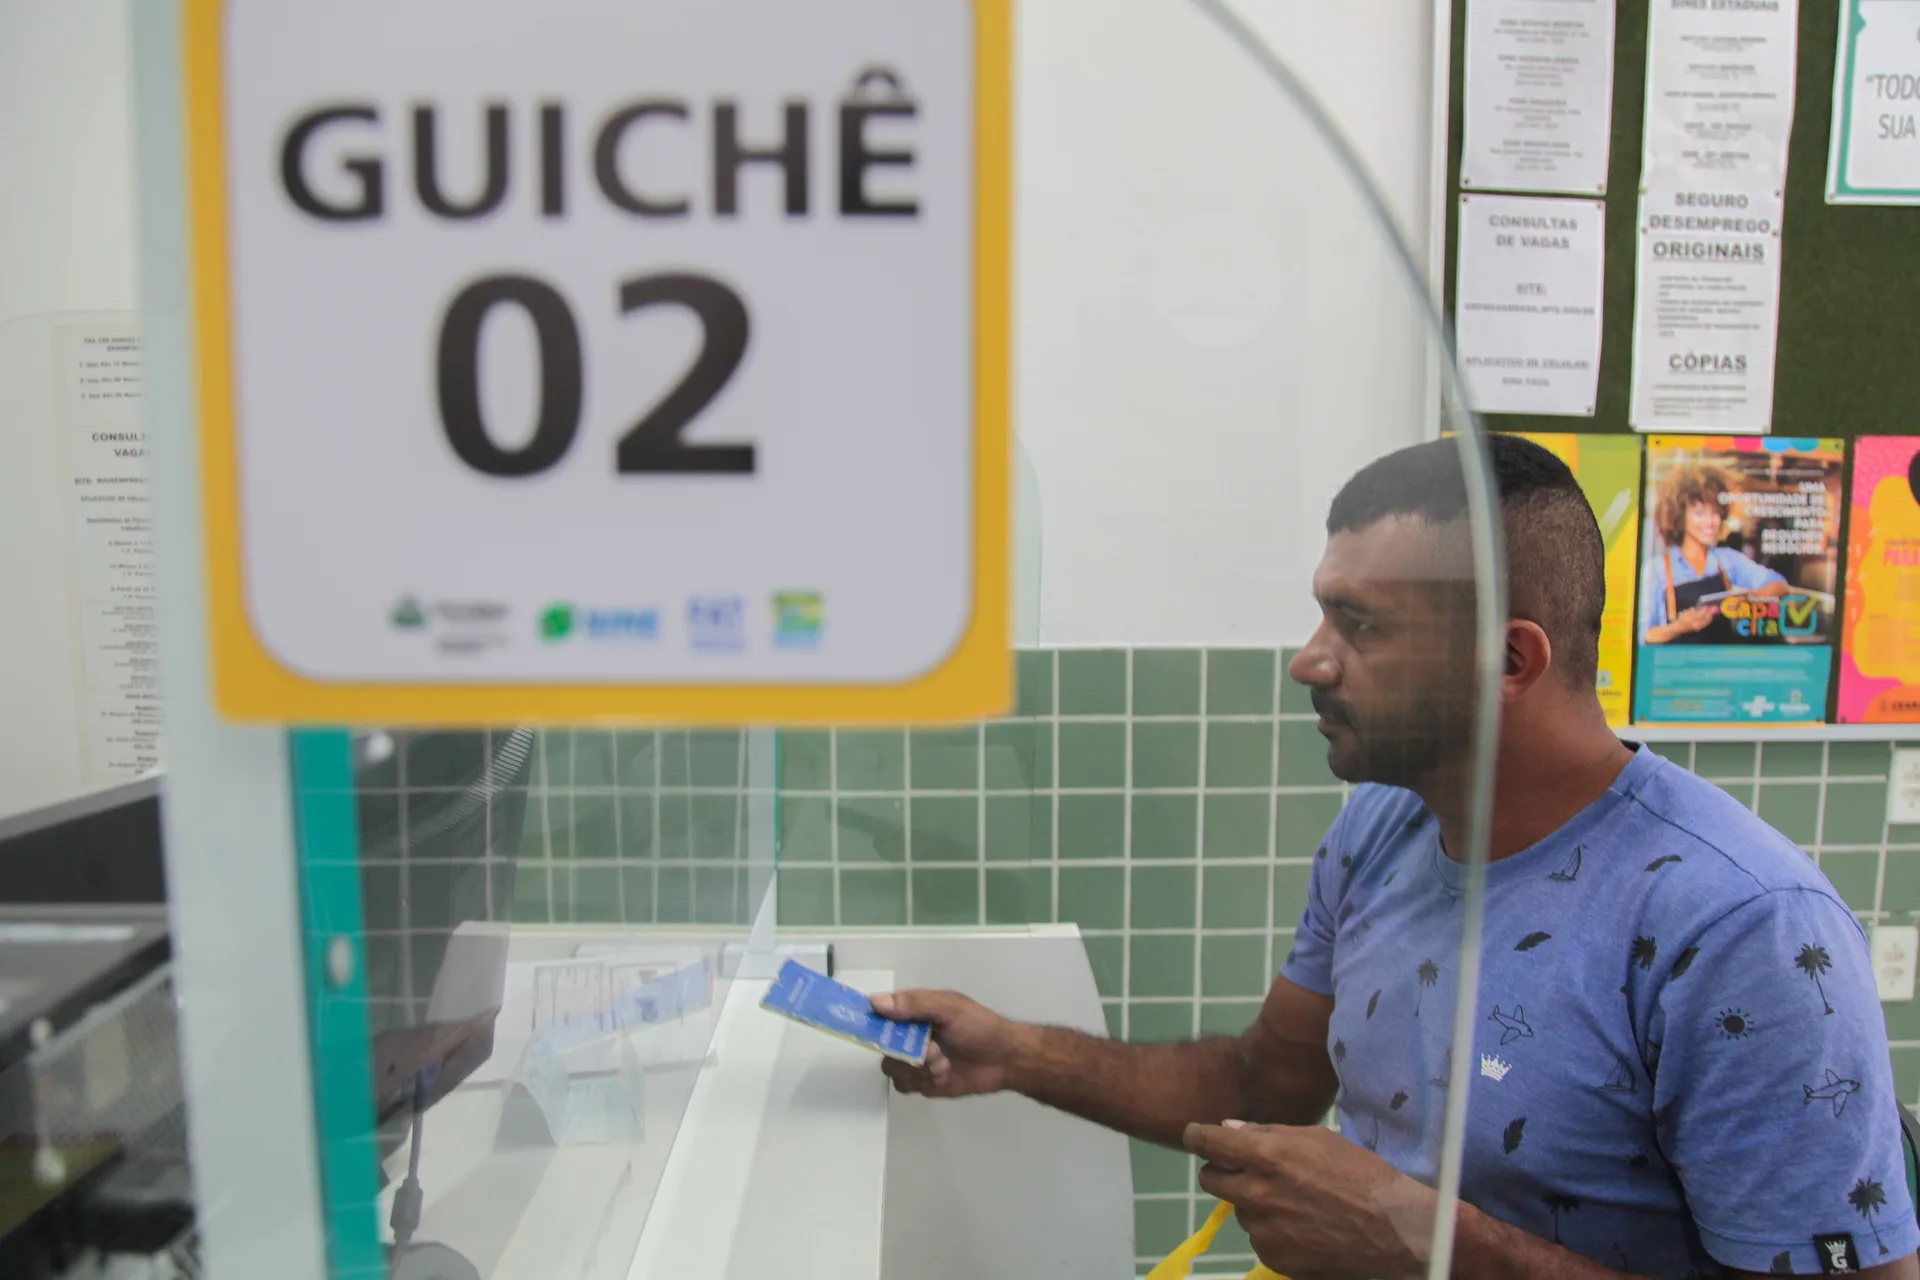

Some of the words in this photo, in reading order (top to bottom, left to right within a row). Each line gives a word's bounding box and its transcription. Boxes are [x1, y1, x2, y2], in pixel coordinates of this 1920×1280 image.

[1878, 113, 1916, 140] SUA
[279, 65, 921, 223] GUICHÊ
[1675, 192, 1749, 208] SEGURO
[1489, 215, 1578, 230] CONSULTAS
[1650, 214, 1771, 234] DESEMPREGO
[1496, 235, 1515, 247] DE
[1521, 236, 1570, 249] VAGAS
[1653, 242, 1765, 259] ORIGINAIS
[1669, 351, 1747, 370] CÓPIAS
[434, 271, 755, 478] 02
[92, 432, 149, 442] CONSULT
[114, 448, 149, 458] VAGA
[1799, 481, 1826, 493] UMA
[1717, 492, 1808, 505] OPORTUNIDADE
[1745, 505, 1826, 518] CRESCIMENTO
[1831, 1252, 1848, 1269] G
